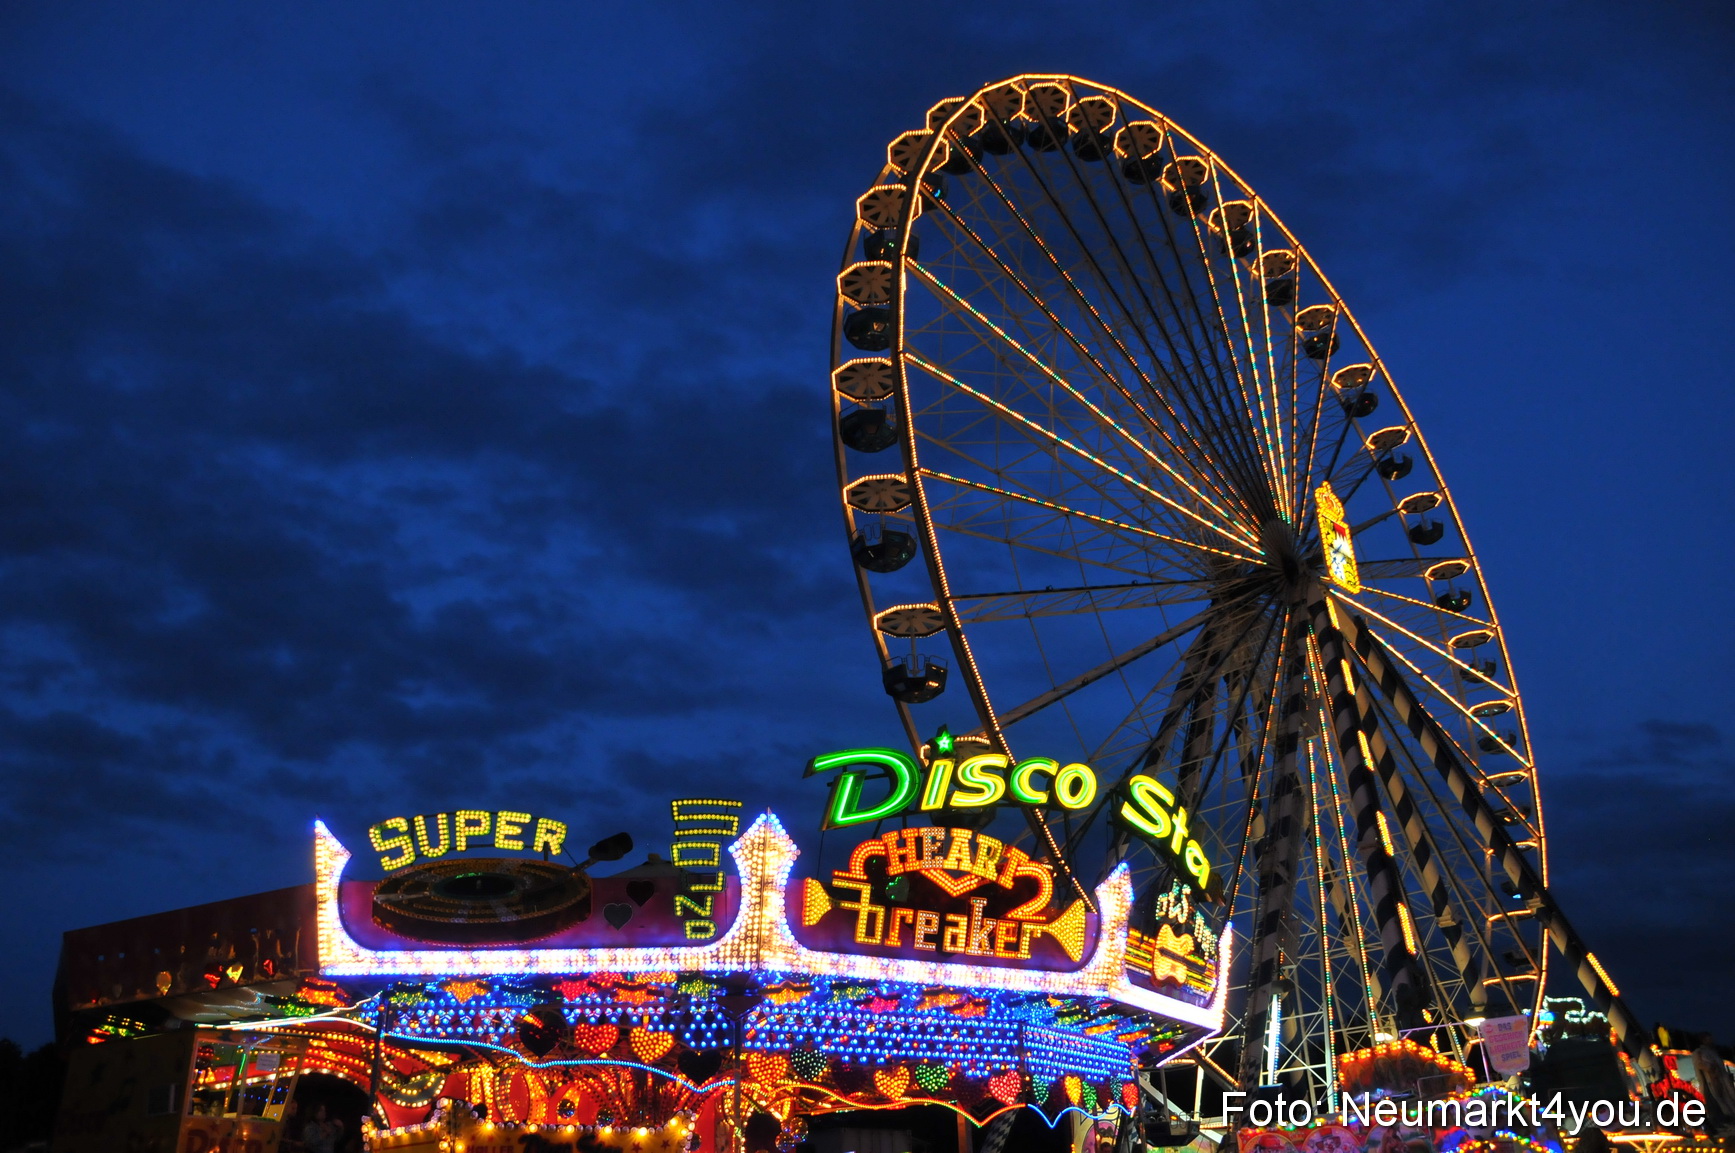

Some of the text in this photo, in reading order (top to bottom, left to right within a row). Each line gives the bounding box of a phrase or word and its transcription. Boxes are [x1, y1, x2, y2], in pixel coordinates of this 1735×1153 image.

[805, 728, 1098, 830] Disco
[368, 809, 568, 872] SUPER
[881, 826, 1031, 891] HEART
[834, 877, 1043, 961] breaker
